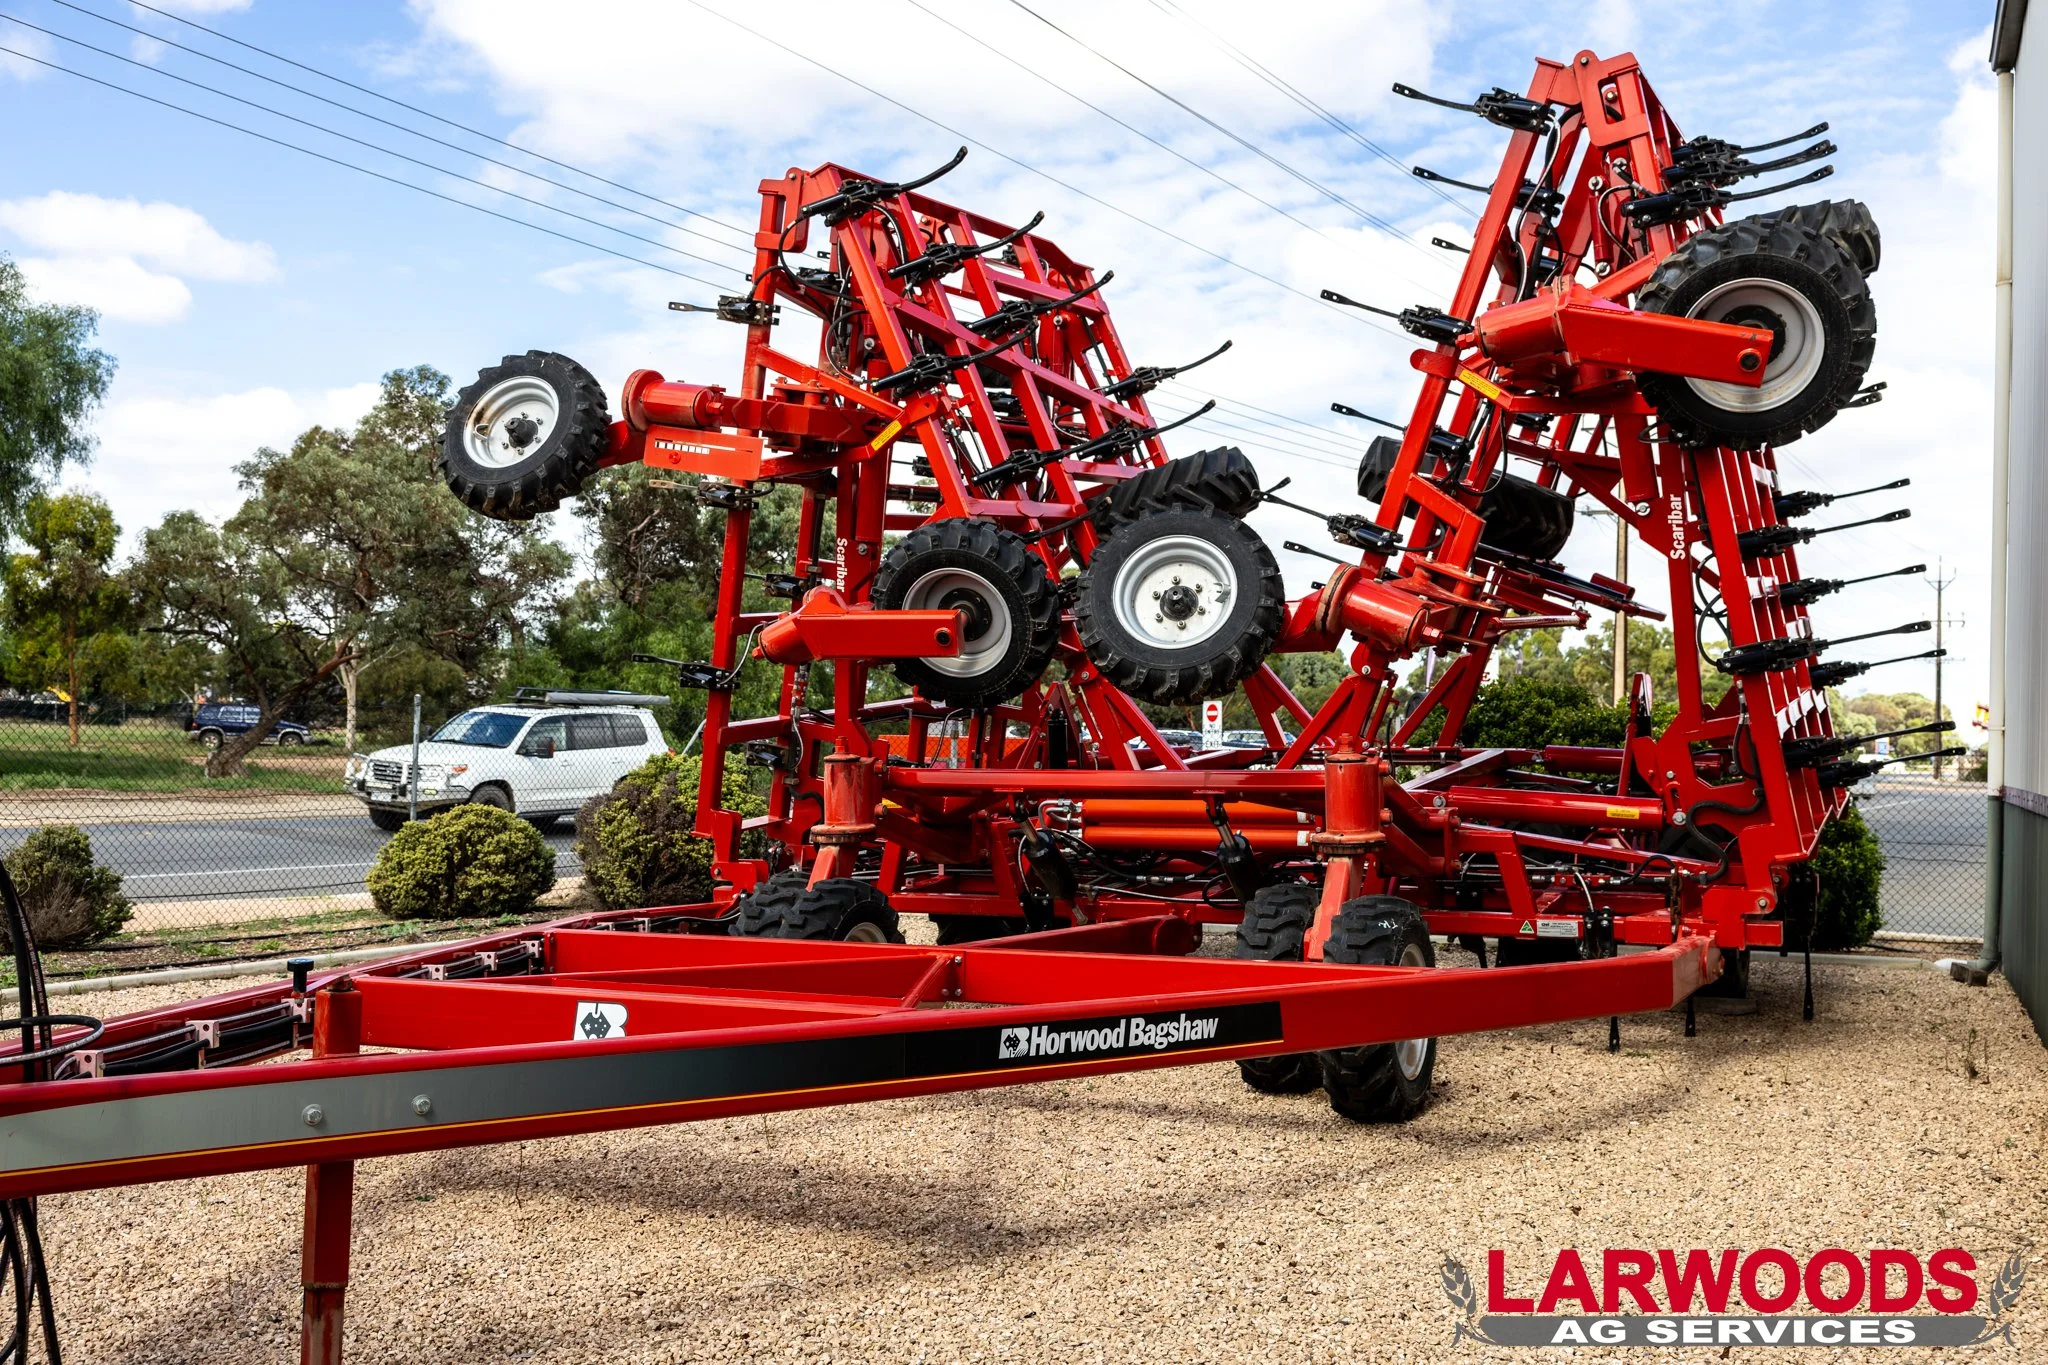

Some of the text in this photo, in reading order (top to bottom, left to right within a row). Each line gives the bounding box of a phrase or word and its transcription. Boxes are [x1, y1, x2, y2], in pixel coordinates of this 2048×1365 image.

[1667, 493, 1686, 560] Scaribar
[836, 537, 848, 593] Scaribar
[1029, 1014, 1219, 1057] Horwood Bagshaw
